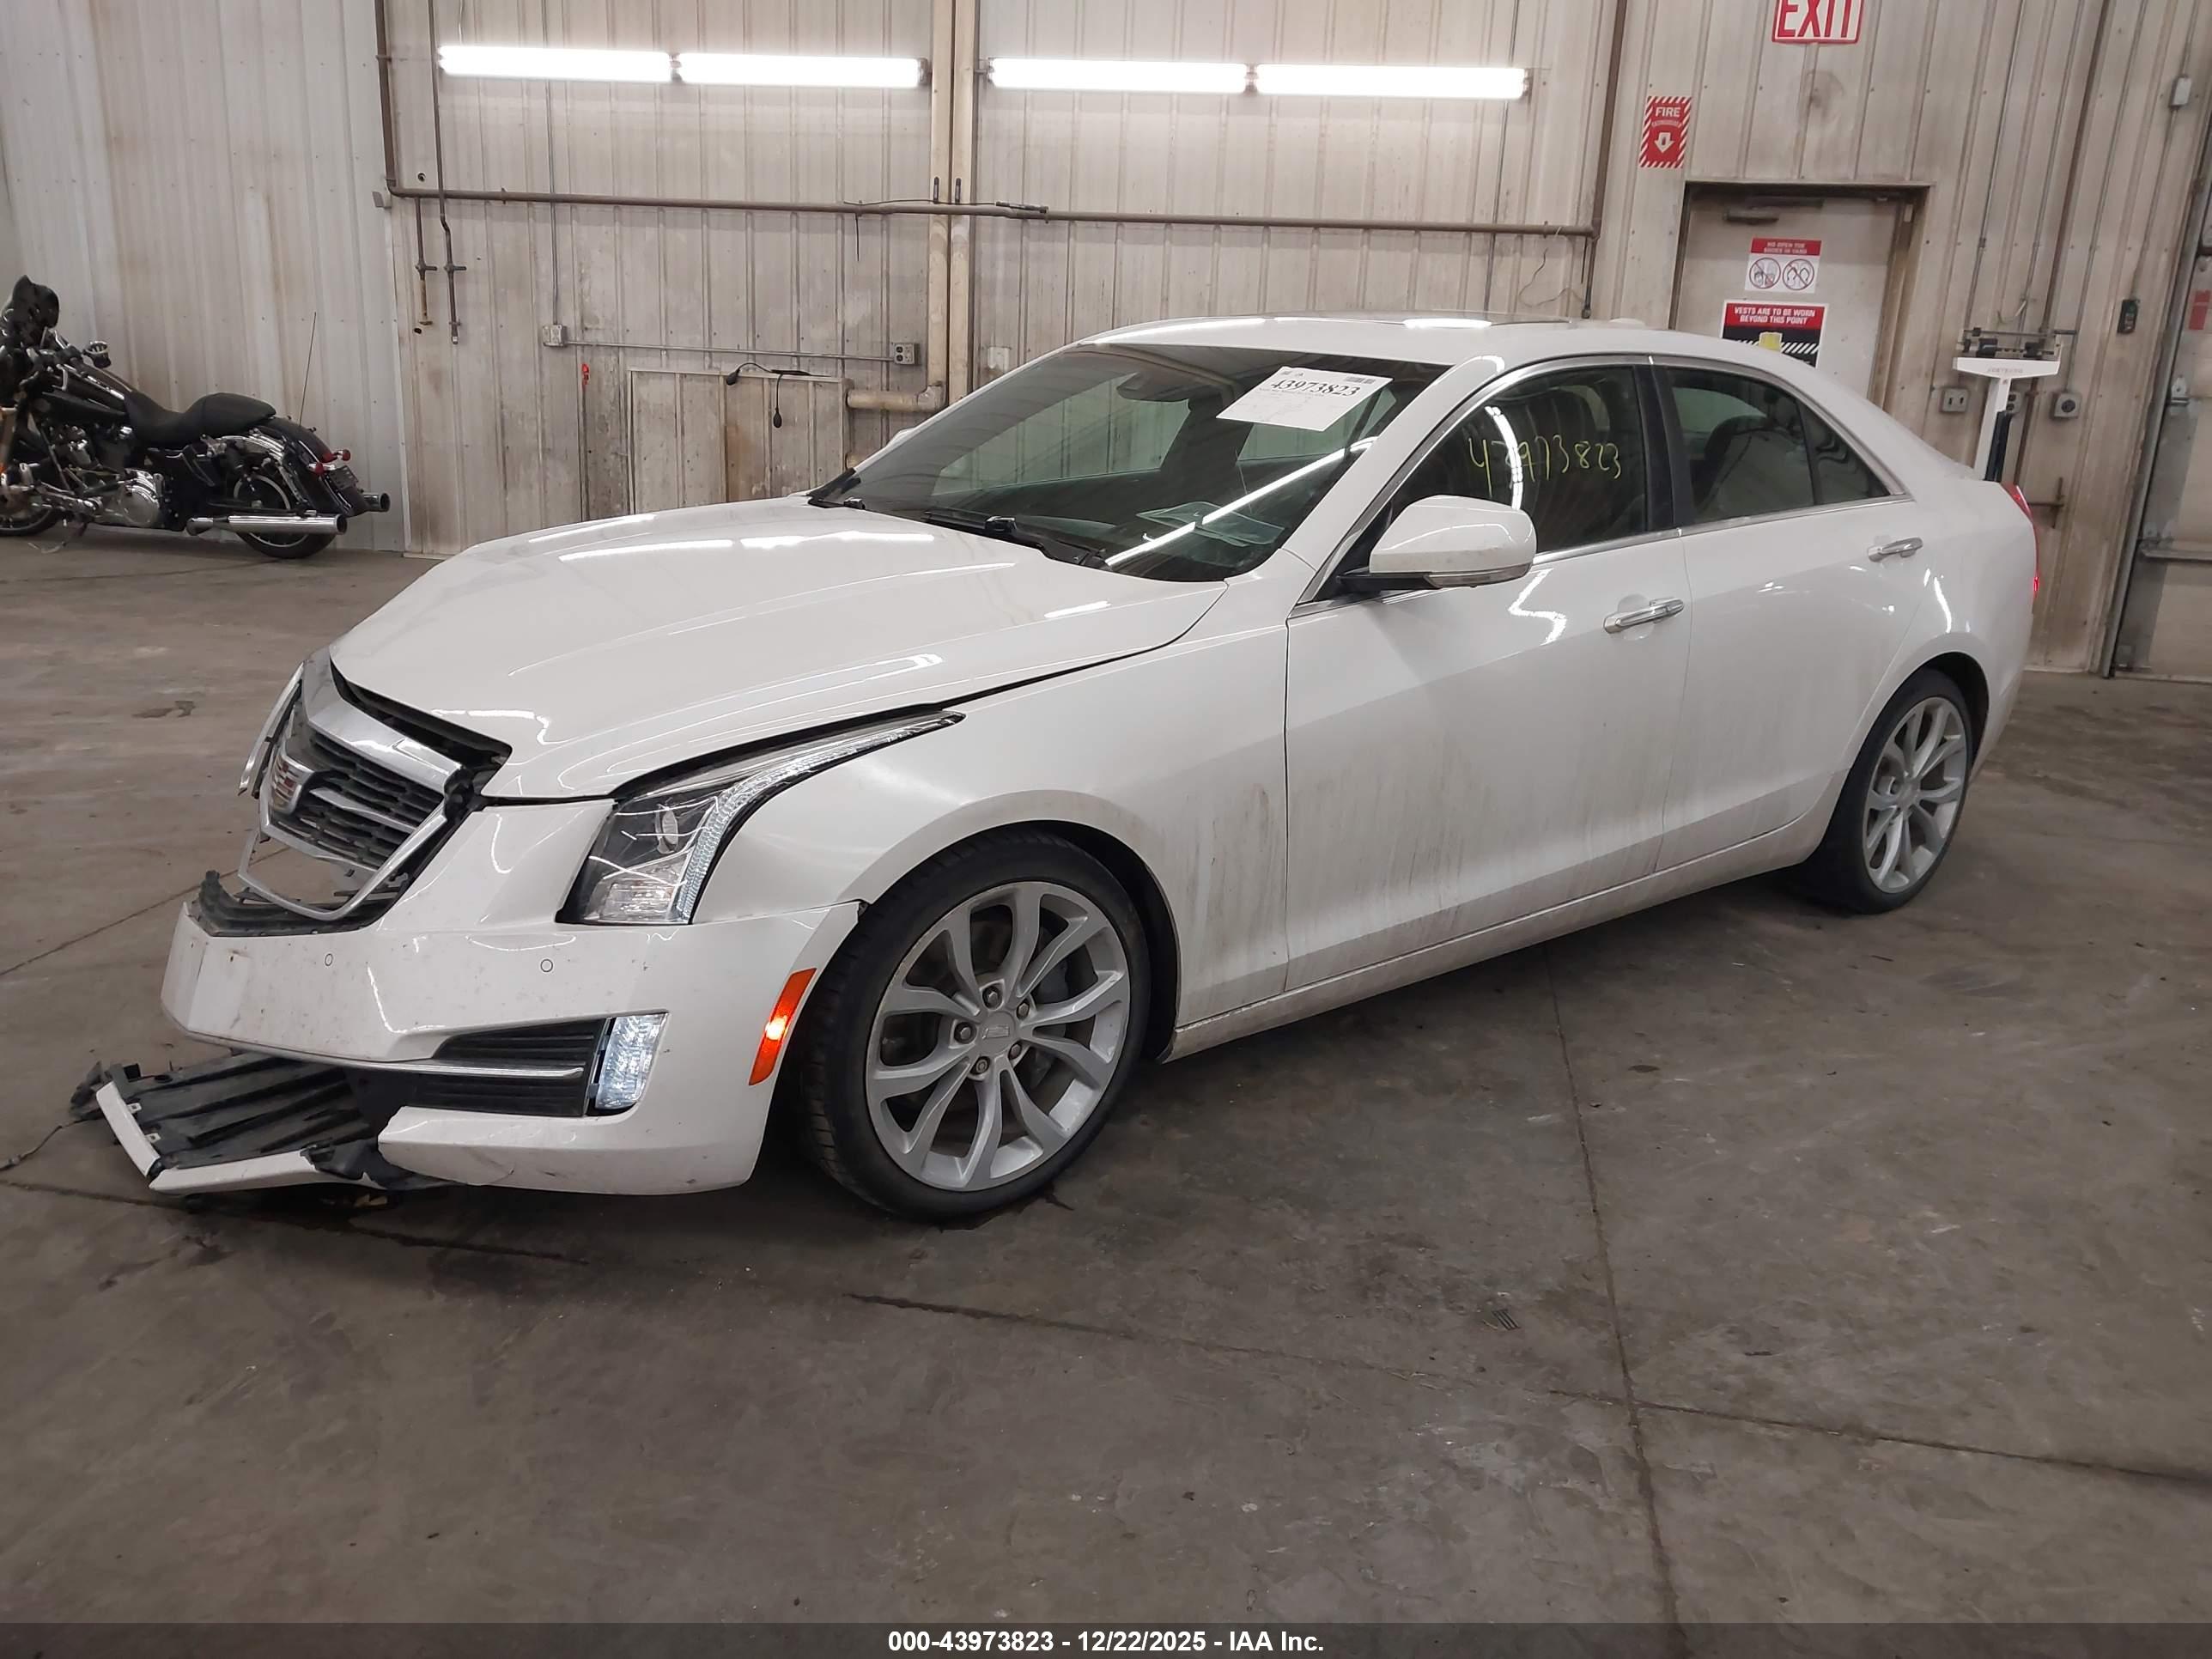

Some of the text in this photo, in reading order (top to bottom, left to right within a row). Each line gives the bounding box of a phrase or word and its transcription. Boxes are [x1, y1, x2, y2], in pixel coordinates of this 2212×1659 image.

[1655, 106, 1681, 118] FIRE
[1735, 307, 1756, 315] VESTS
[1793, 309, 1815, 318] WORN
[1740, 314, 1808, 325] BEYOND THIS POINT
[1270, 379, 1361, 397] 43973823
